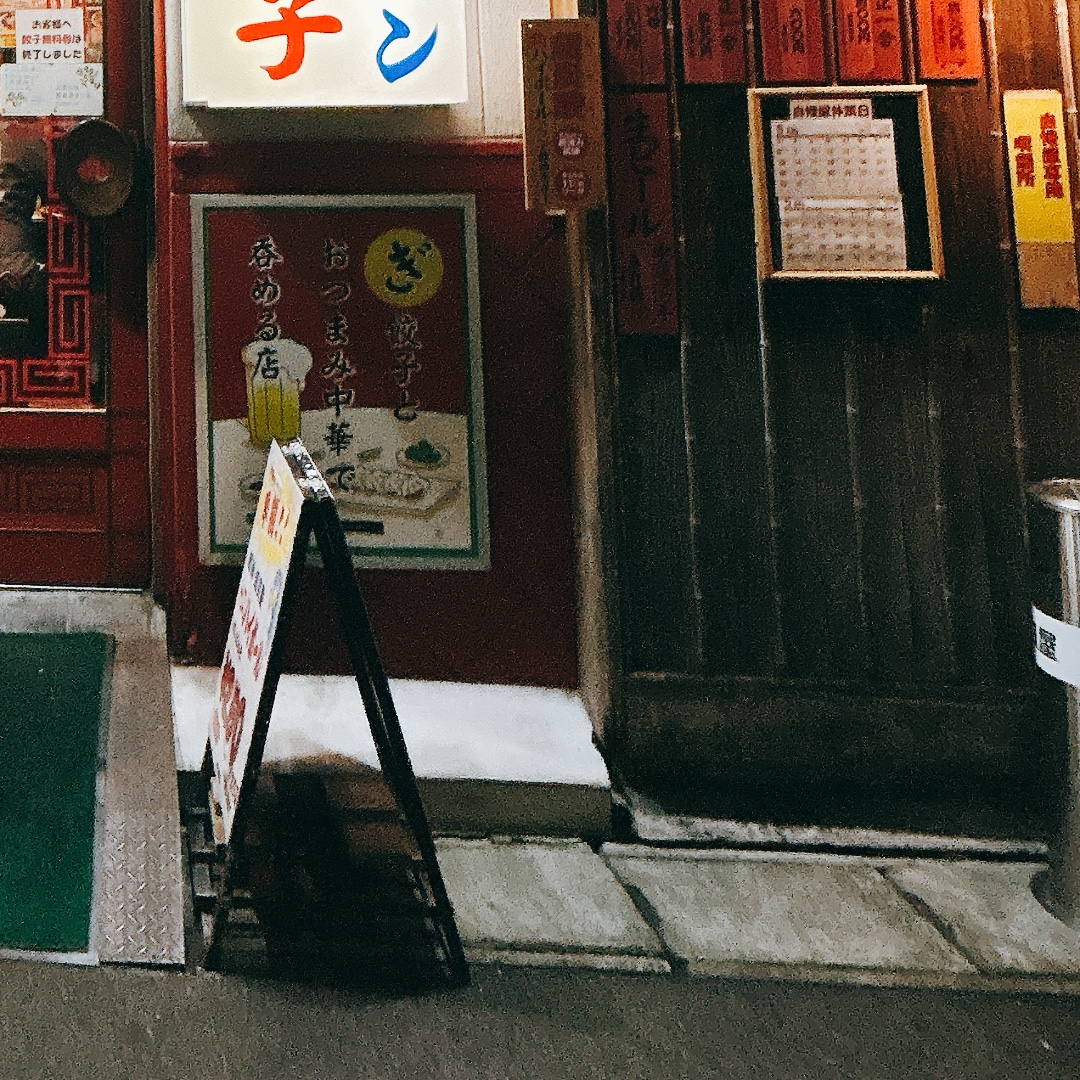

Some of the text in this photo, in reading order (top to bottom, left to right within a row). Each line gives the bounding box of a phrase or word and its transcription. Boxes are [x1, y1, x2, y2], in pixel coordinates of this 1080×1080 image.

[248, 234, 284, 380] 呑める店
[322, 236, 357, 491] おつまみ中華で
